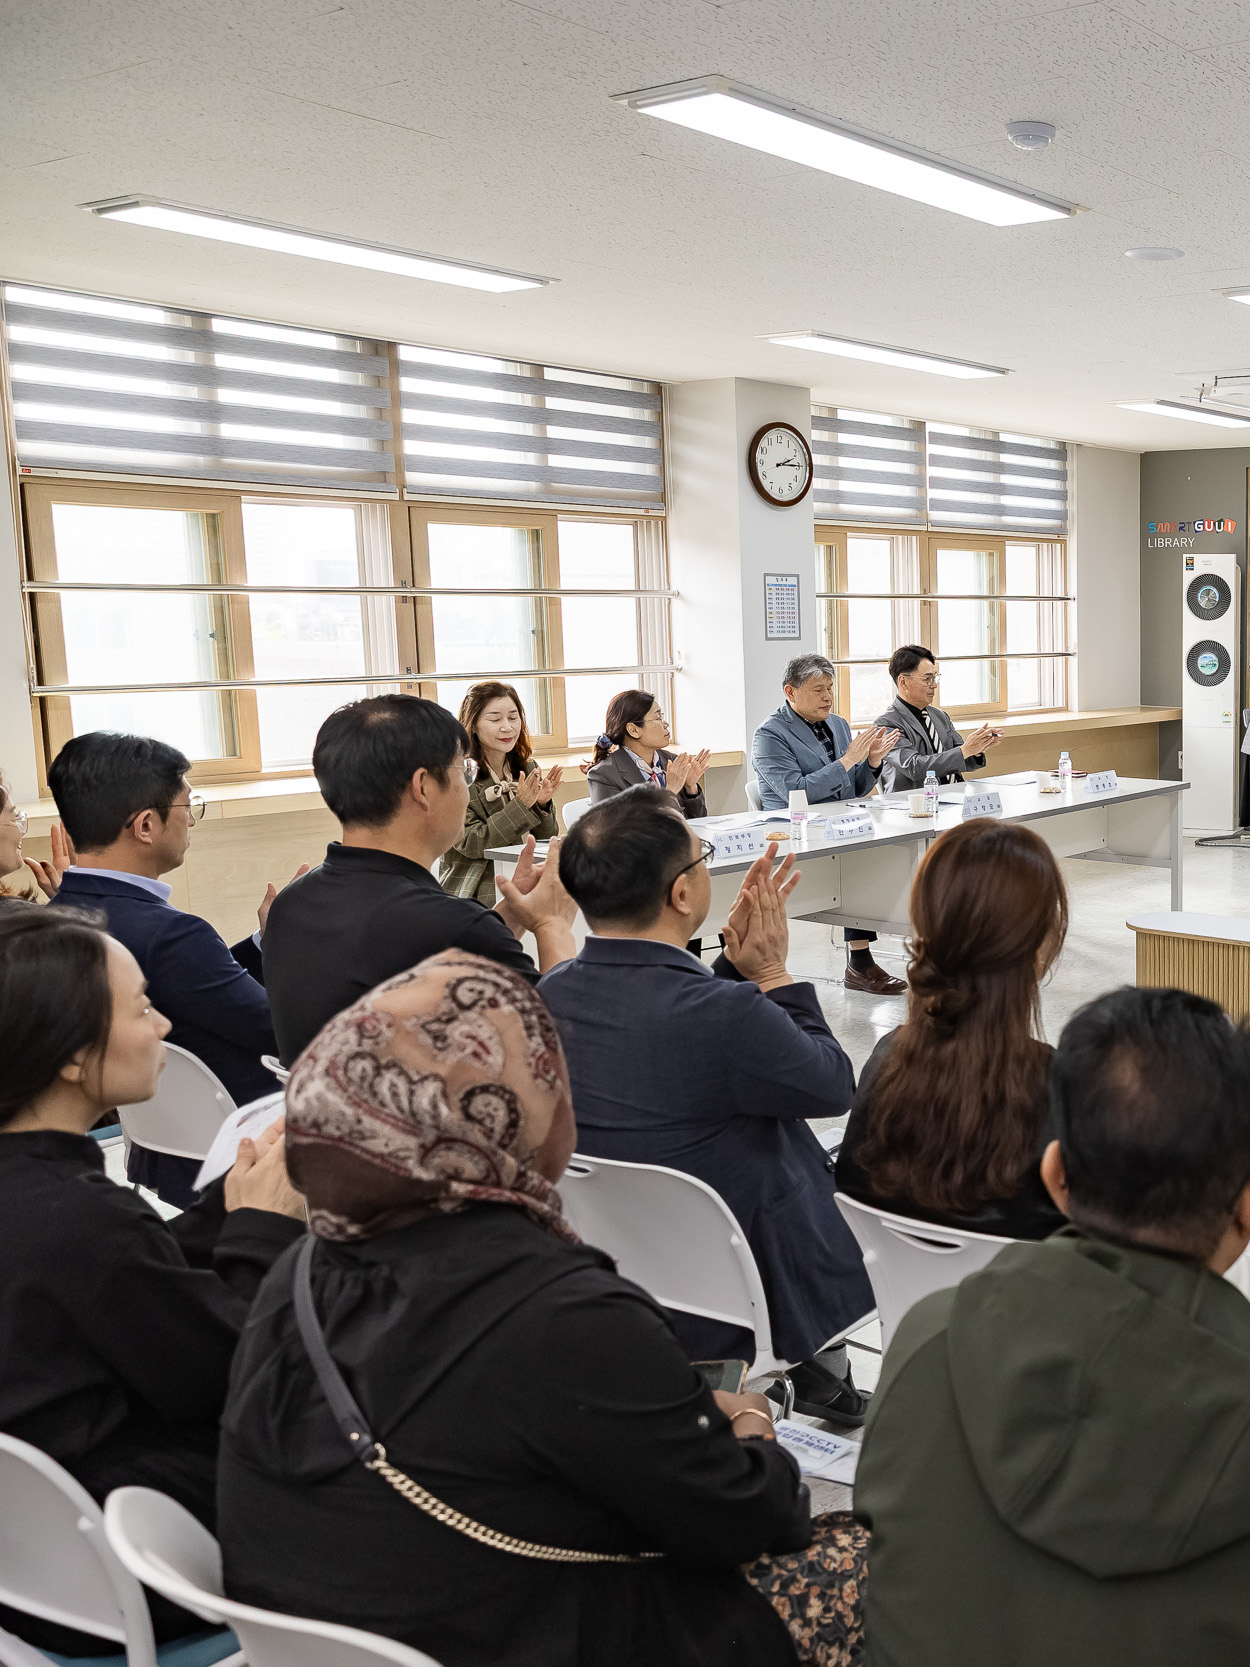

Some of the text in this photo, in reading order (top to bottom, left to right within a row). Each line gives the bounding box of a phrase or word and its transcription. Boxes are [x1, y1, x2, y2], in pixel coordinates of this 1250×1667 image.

[767, 438, 772, 446] 11
[777, 436, 782, 444] 12
[761, 447, 767, 455] 10
[794, 449, 797, 457] 2
[760, 459, 764, 467] 9
[762, 471, 767, 480] 8
[770, 482, 773, 490] 7
[779, 486, 783, 494] 6
[788, 483, 792, 491] 5
[1148, 538, 1195, 547] LIBRARY
